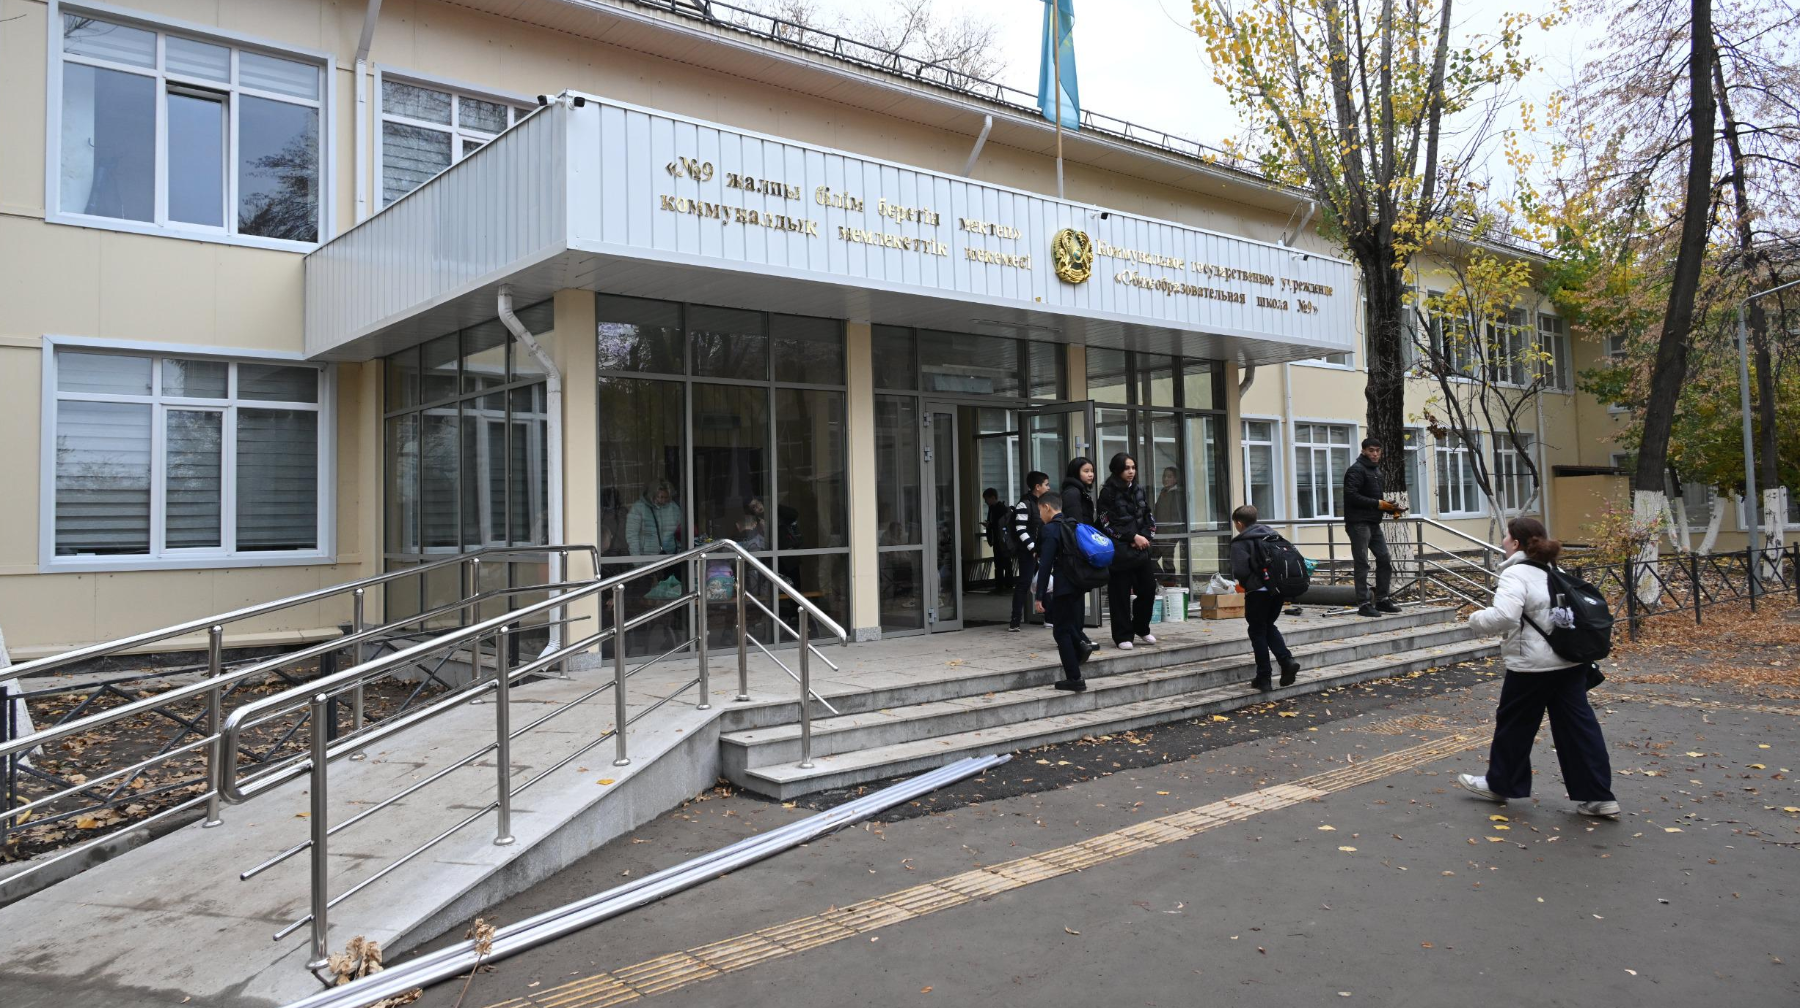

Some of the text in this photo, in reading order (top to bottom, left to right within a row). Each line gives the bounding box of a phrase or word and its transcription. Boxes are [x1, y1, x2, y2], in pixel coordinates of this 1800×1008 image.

[665, 156, 1022, 240] «№9 жалпы білім беретін мектеп»
[838, 225, 947, 257] мемлекеттік
[965, 247, 1032, 270] мекемесі
[1096, 239, 1333, 297] Коммунальное государственное учреждение
[1257, 295, 1288, 311] школа
[1297, 300, 1319, 315] №9»
